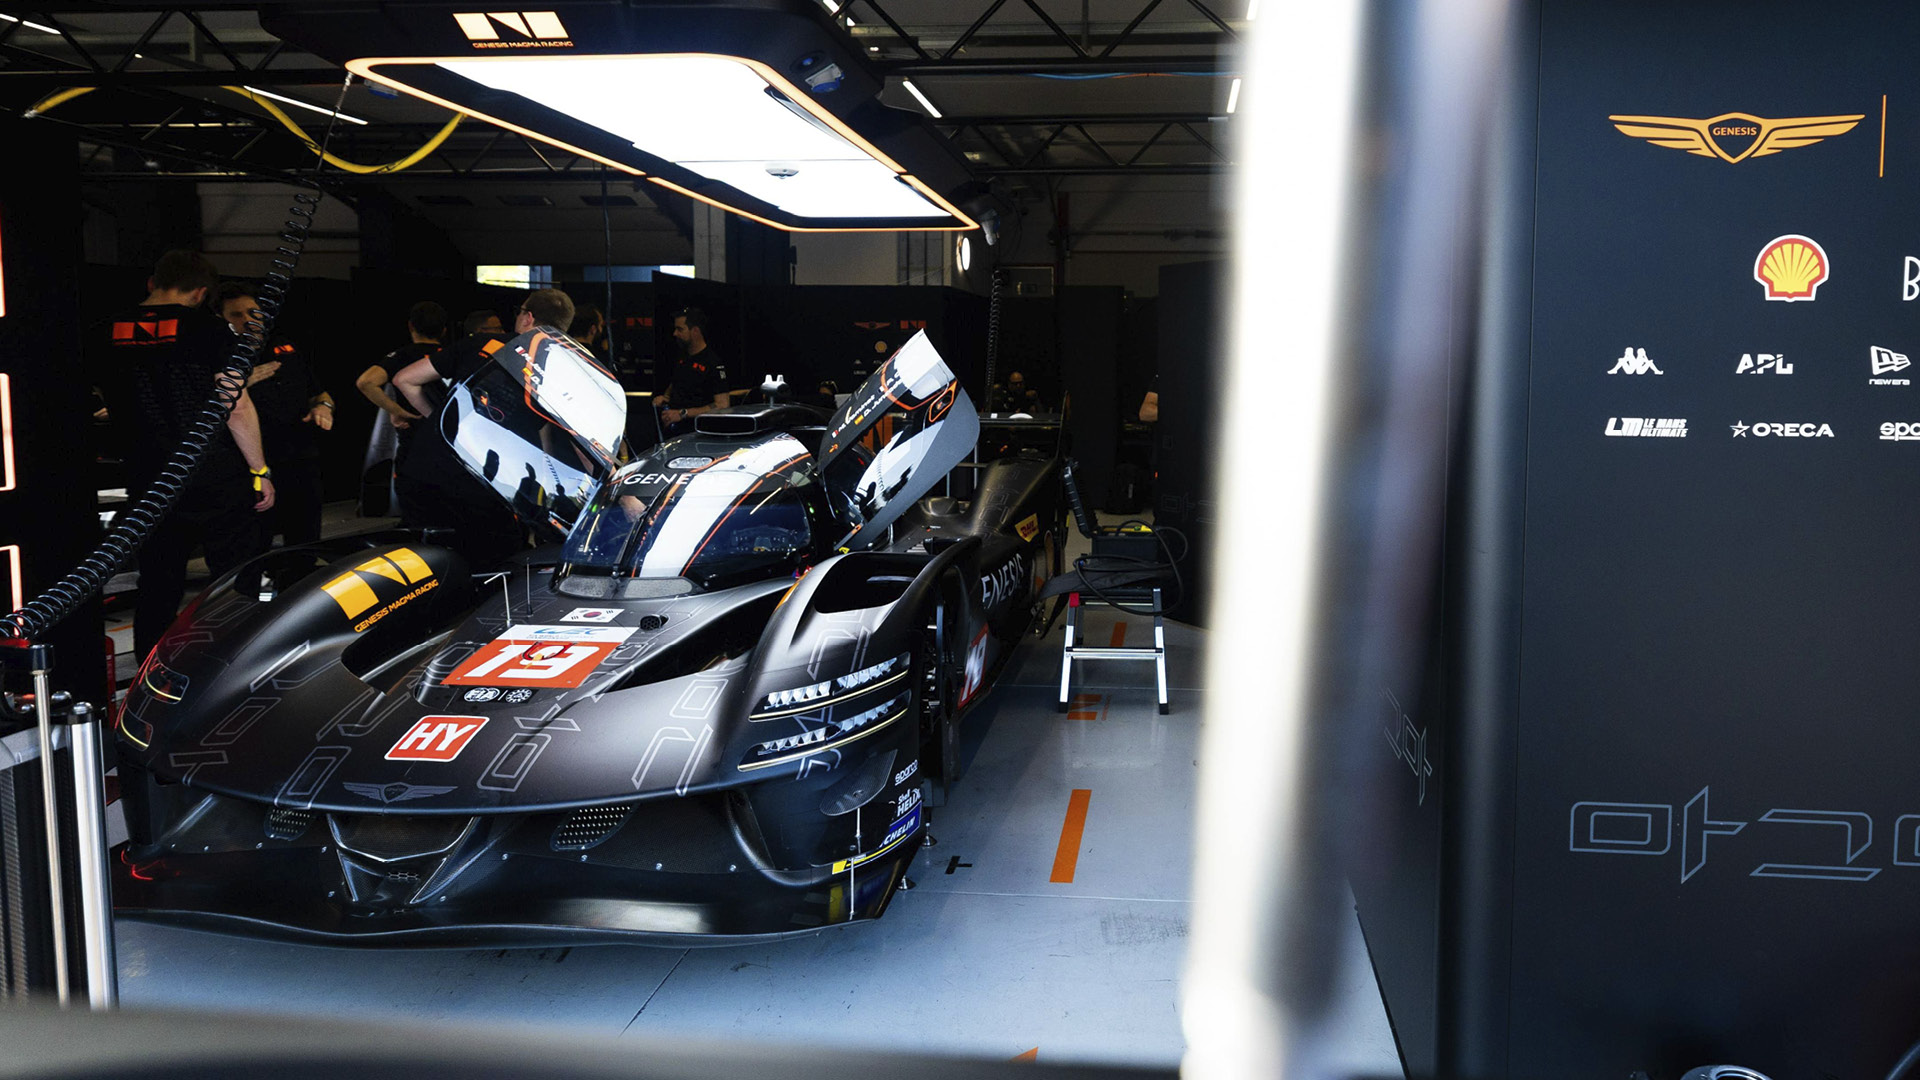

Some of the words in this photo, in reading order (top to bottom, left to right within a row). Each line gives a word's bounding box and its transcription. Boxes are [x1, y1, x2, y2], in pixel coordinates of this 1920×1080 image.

[1712, 125, 1758, 137] GENESIS
[1736, 353, 1794, 375] APL
[1640, 428, 1689, 438] ULTIMATE
[1752, 422, 1835, 437] ORECA
[981, 552, 1025, 610] ENESIS
[354, 606, 390, 634] GENESIS
[388, 592, 417, 612] MAGMA
[414, 578, 439, 597] RACING
[462, 644, 601, 680] 19
[398, 723, 479, 752] HY
[894, 759, 919, 786] sparco
[896, 787, 922, 817] HELIX
